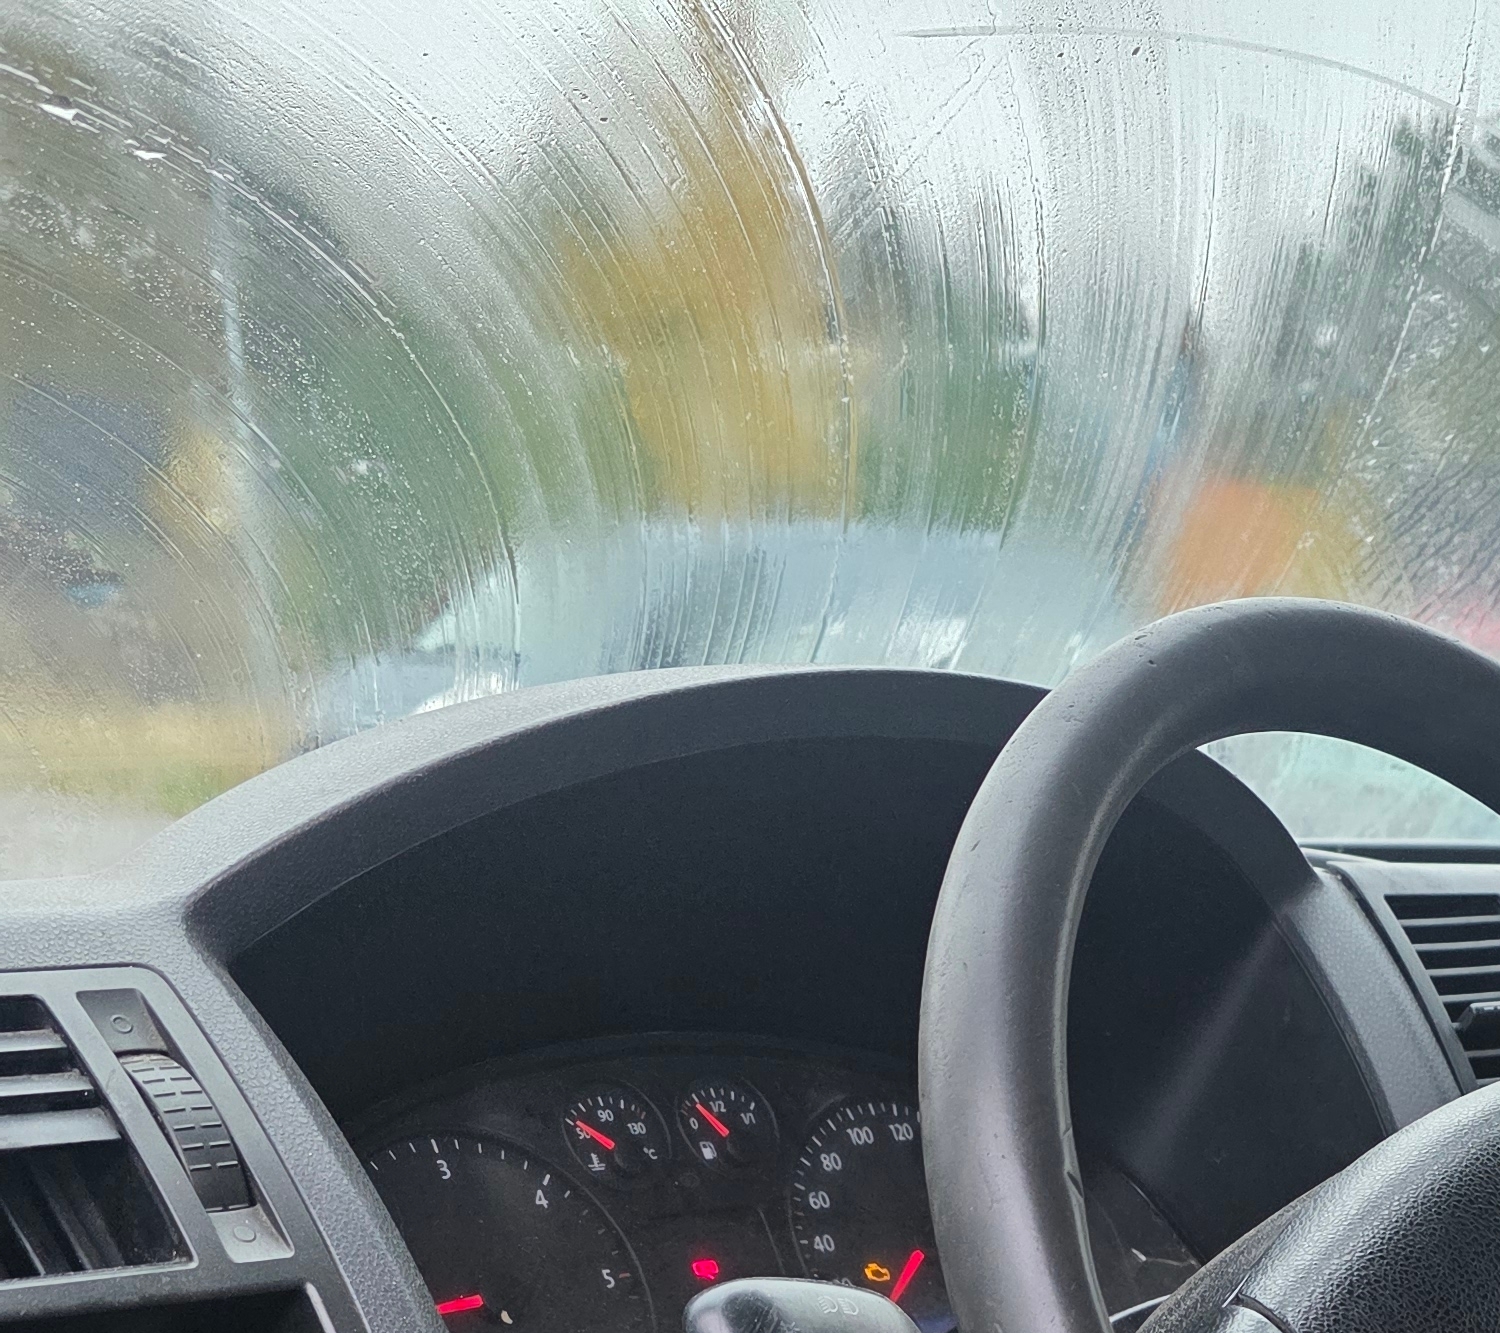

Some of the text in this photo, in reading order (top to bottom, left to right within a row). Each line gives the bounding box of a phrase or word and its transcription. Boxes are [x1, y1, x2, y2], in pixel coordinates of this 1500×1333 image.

[597, 1108, 614, 1122] 90
[689, 1117, 699, 1130] 0
[627, 1121, 647, 1136] 130
[846, 1125, 874, 1147] 100
[888, 1122, 914, 1142] 120
[437, 1159, 452, 1180] 3
[820, 1152, 842, 1172] 80
[535, 1189, 549, 1209] 4
[808, 1190, 831, 1210] 60
[813, 1233, 836, 1253] 40
[602, 1268, 615, 1289] 5
